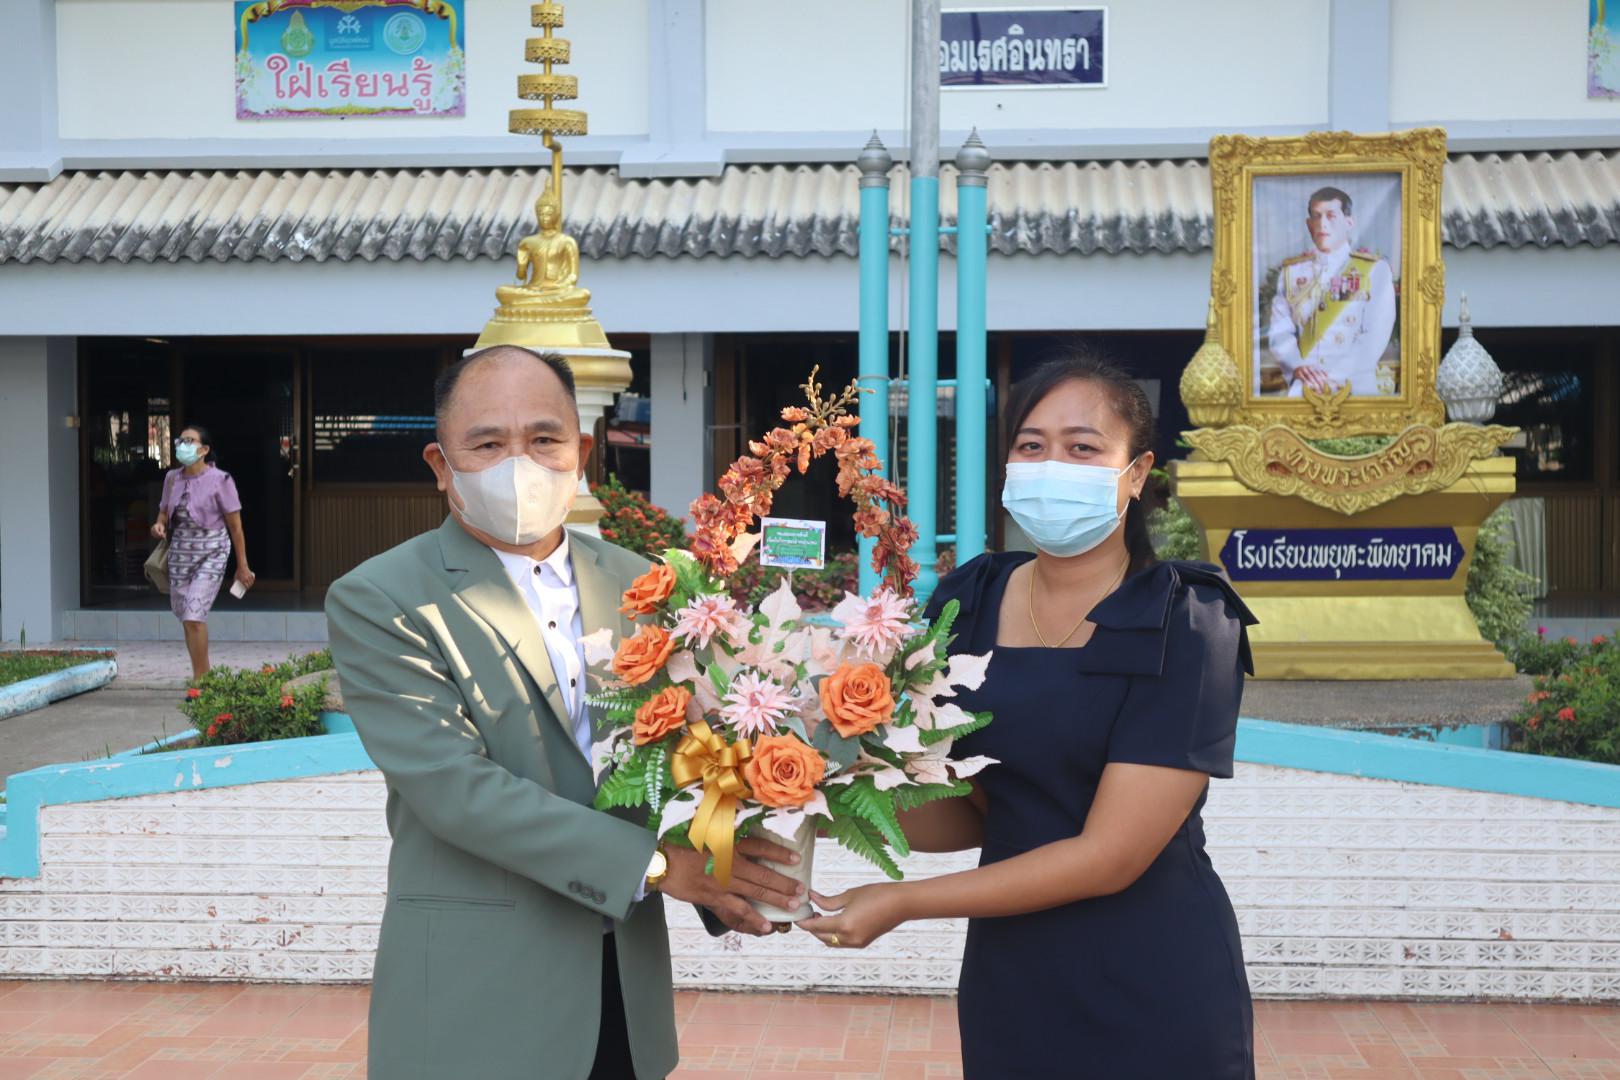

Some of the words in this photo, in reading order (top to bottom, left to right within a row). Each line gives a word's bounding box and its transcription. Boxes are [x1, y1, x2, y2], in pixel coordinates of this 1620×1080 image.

[266, 55, 432, 111] ใฝ่เรียนรู้
[1233, 530, 1452, 579] โรงเรียนพยุหะพิทยาคม
